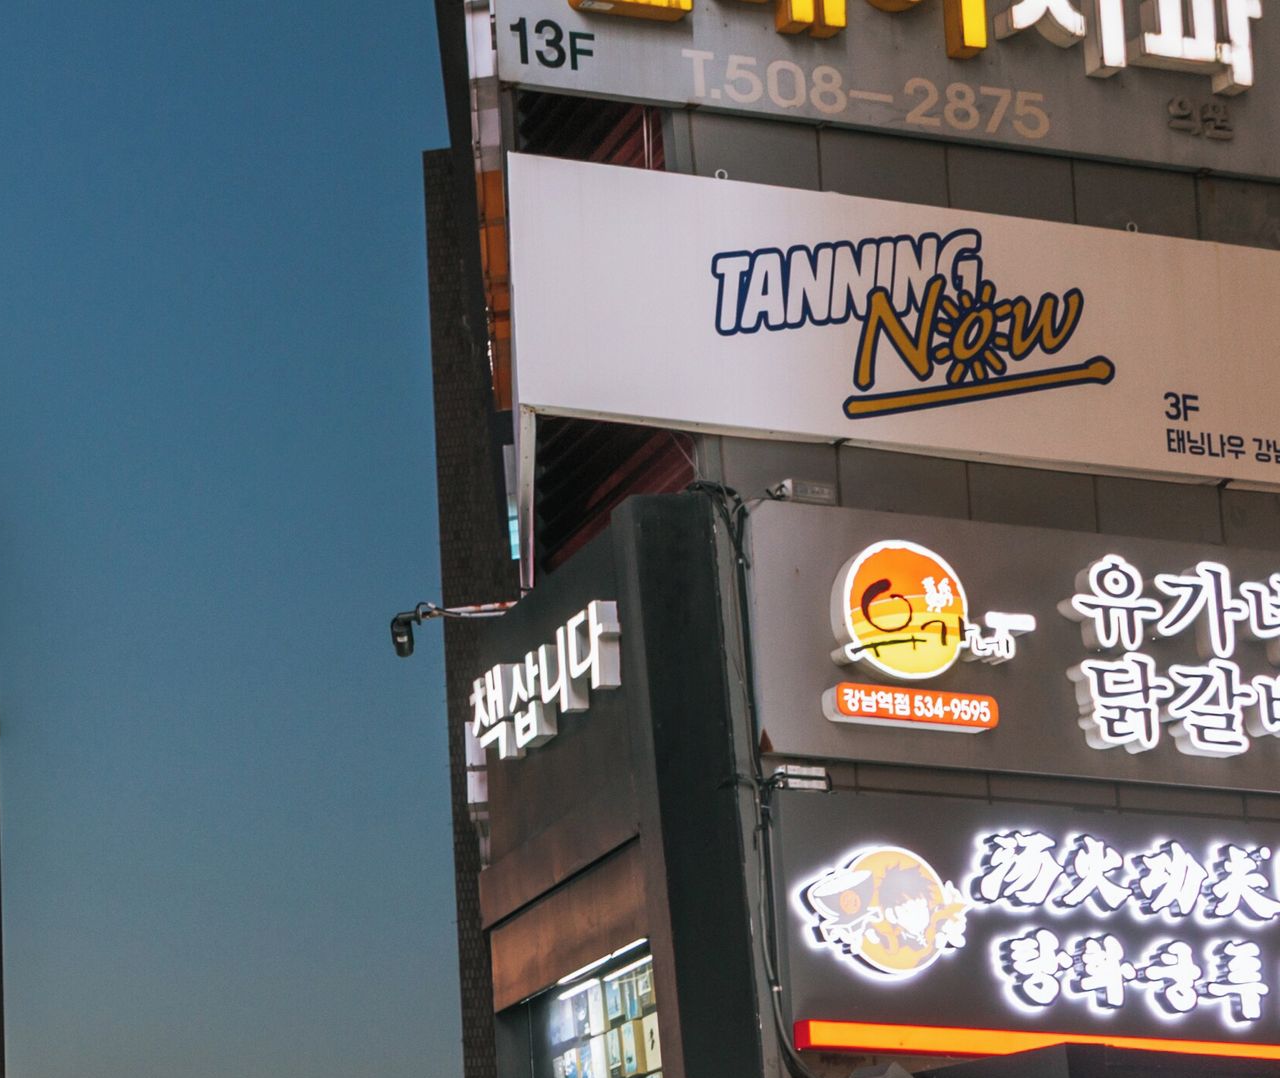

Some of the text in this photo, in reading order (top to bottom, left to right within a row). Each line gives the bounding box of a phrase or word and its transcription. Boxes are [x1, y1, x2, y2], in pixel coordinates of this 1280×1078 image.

[509, 17, 595, 72] 13F
[712, 228, 981, 336] TANNING
[1164, 392, 1199, 421] 3F
[1166, 428, 1246, 460] 태닝나우
[843, 688, 991, 722] 강남역점 534-9595
